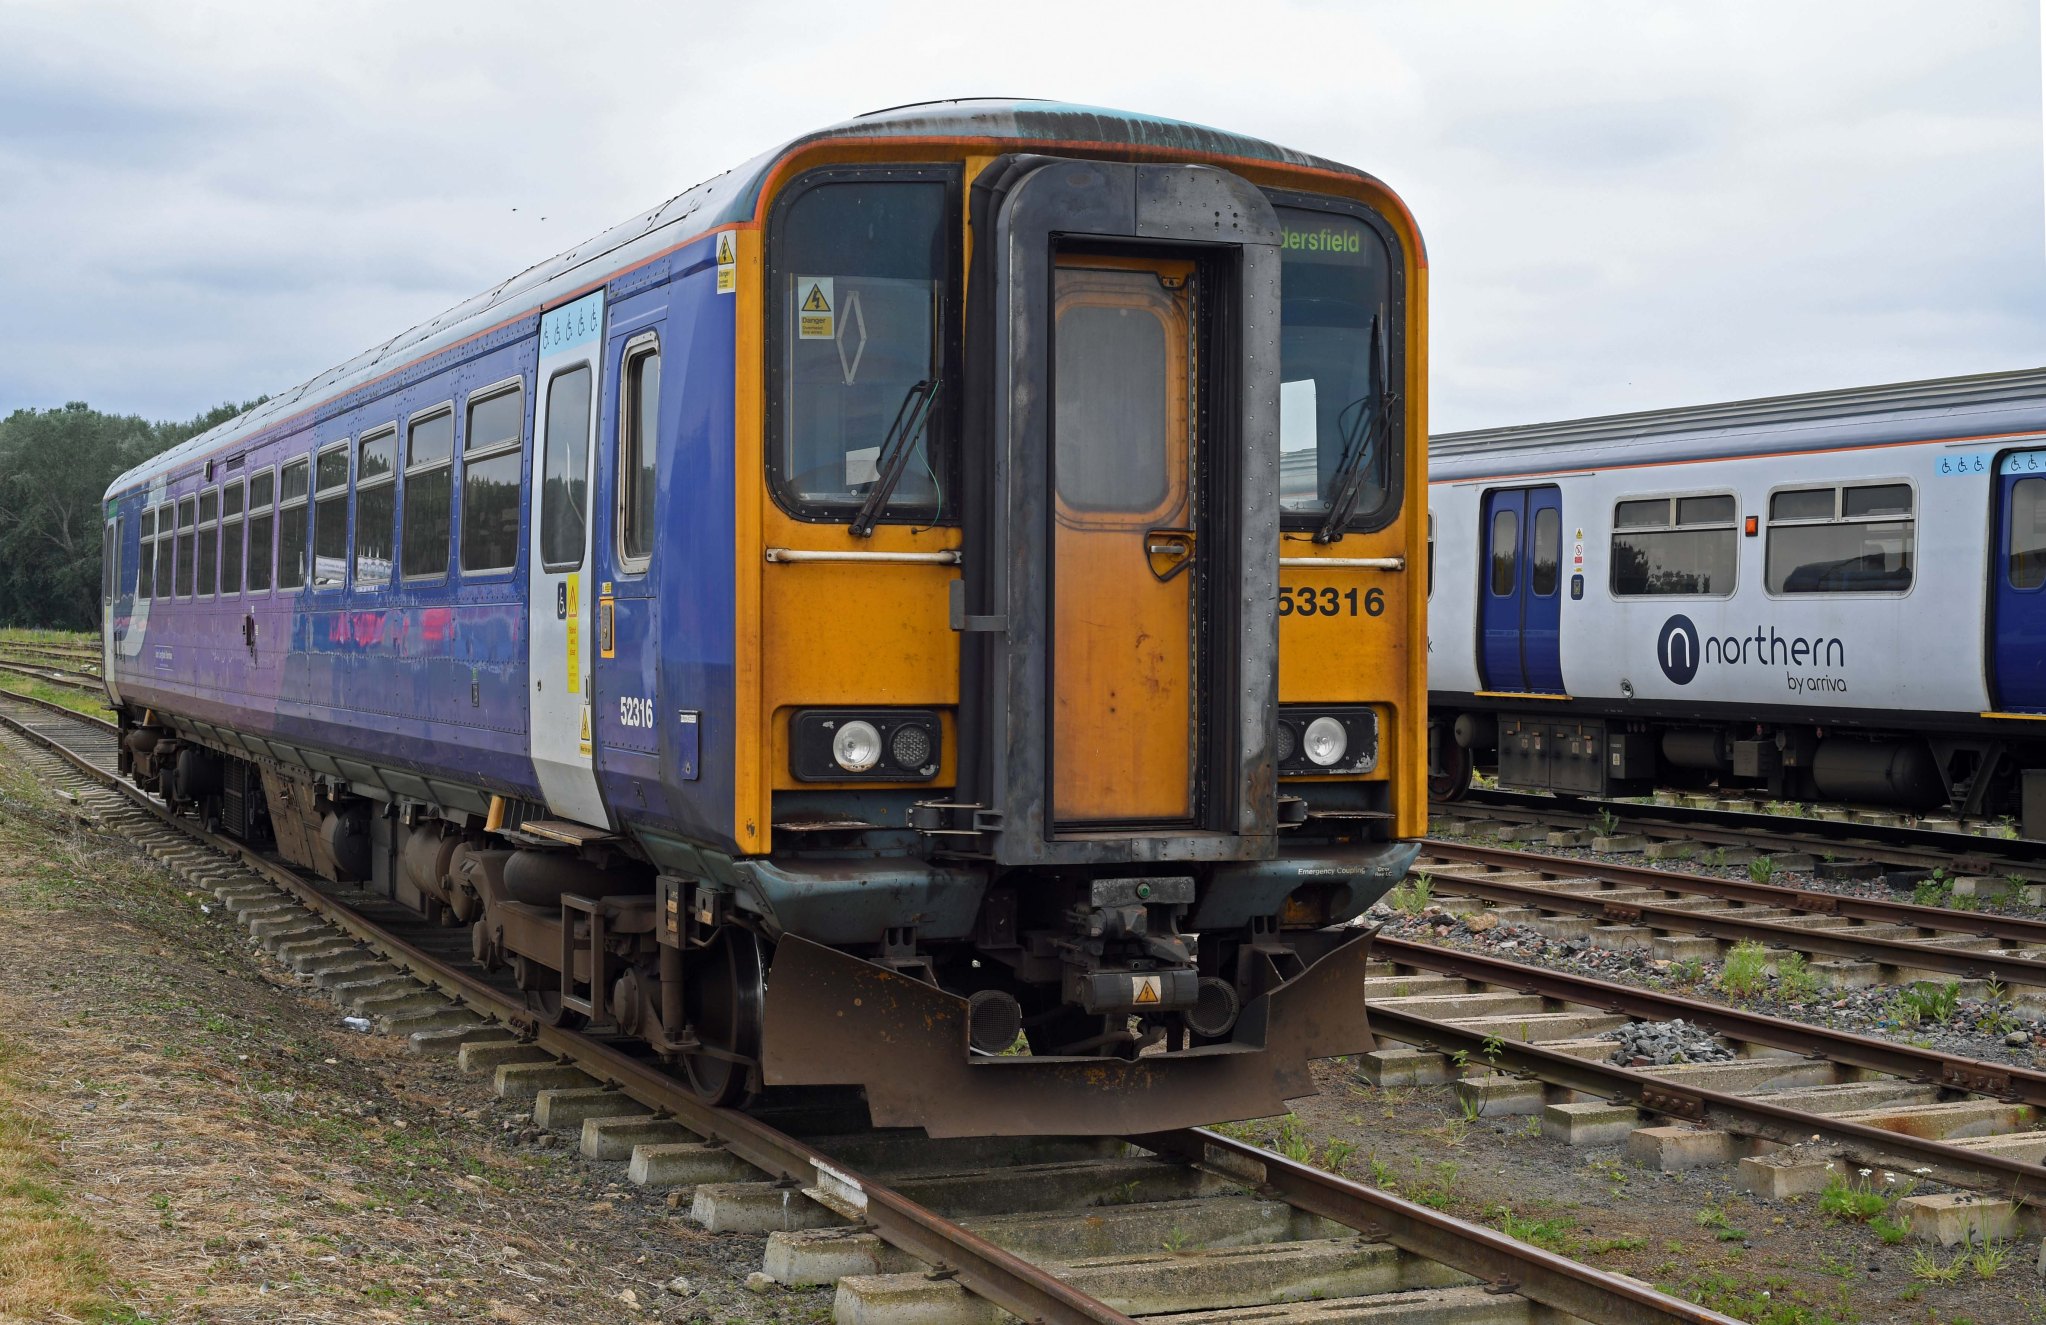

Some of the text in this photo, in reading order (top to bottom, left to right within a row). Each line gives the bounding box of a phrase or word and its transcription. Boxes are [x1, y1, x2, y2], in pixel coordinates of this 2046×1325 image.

[1279, 587, 1385, 616] 53316
[1706, 625, 1844, 667] northern
[1787, 671, 1847, 695] by arriva
[620, 696, 653, 729] 52316
